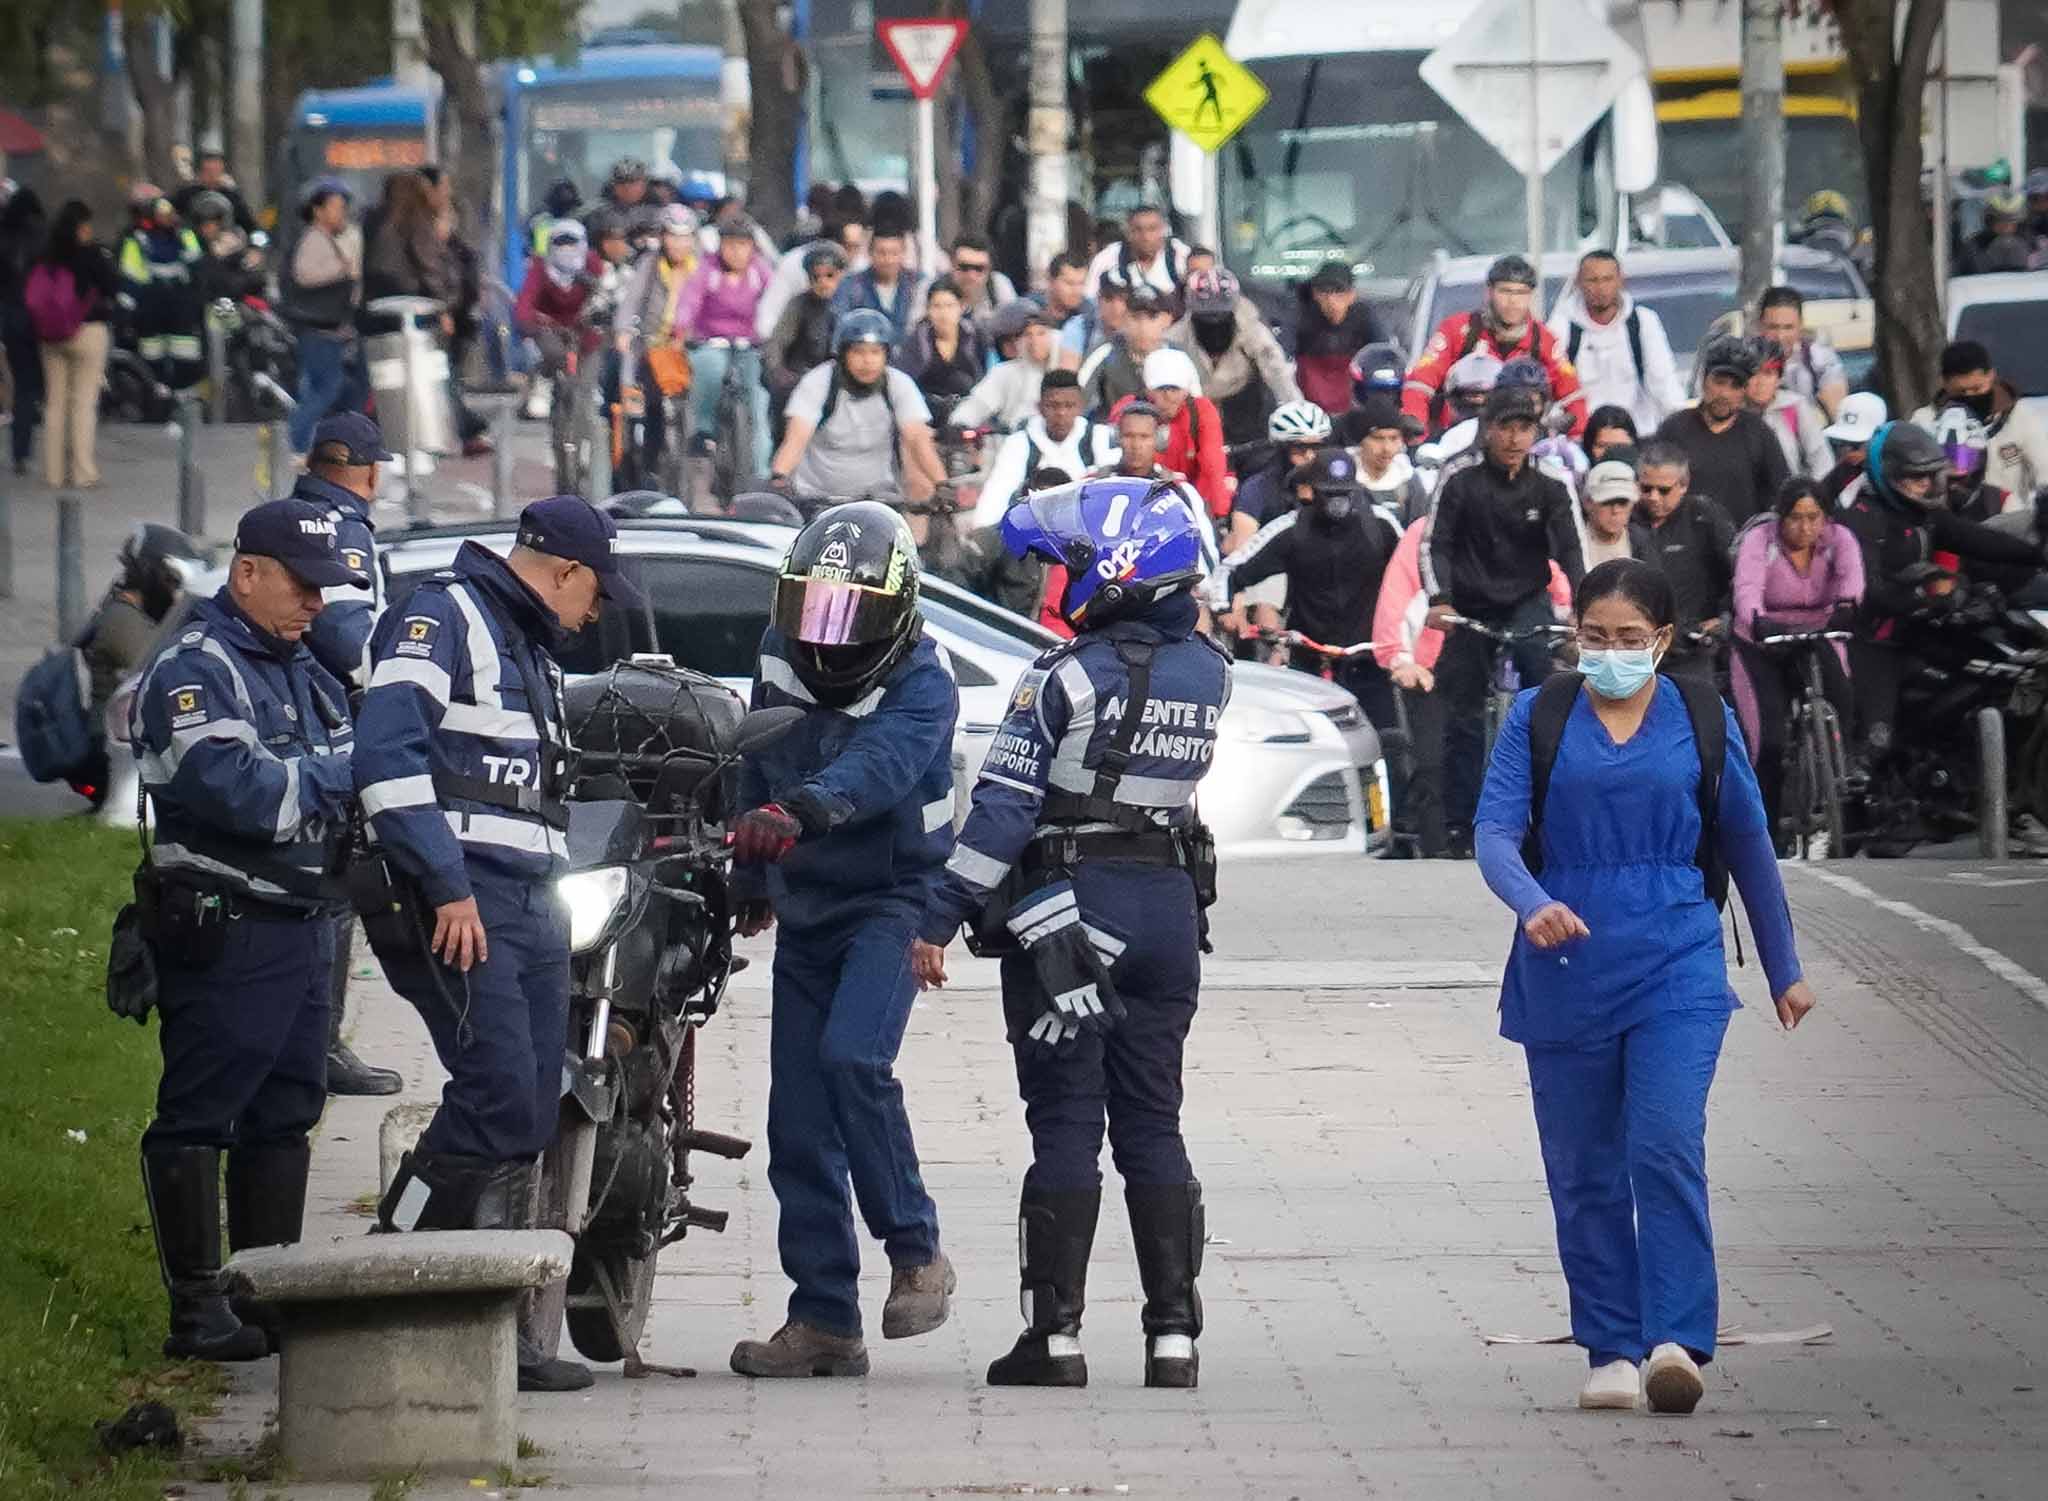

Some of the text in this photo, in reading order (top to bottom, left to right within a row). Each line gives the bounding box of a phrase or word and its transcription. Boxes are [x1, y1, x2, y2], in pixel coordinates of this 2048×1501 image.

[1097, 541, 1141, 580] 012
[1204, 705, 1220, 730] D
[1032, 743, 1041, 758] Y
